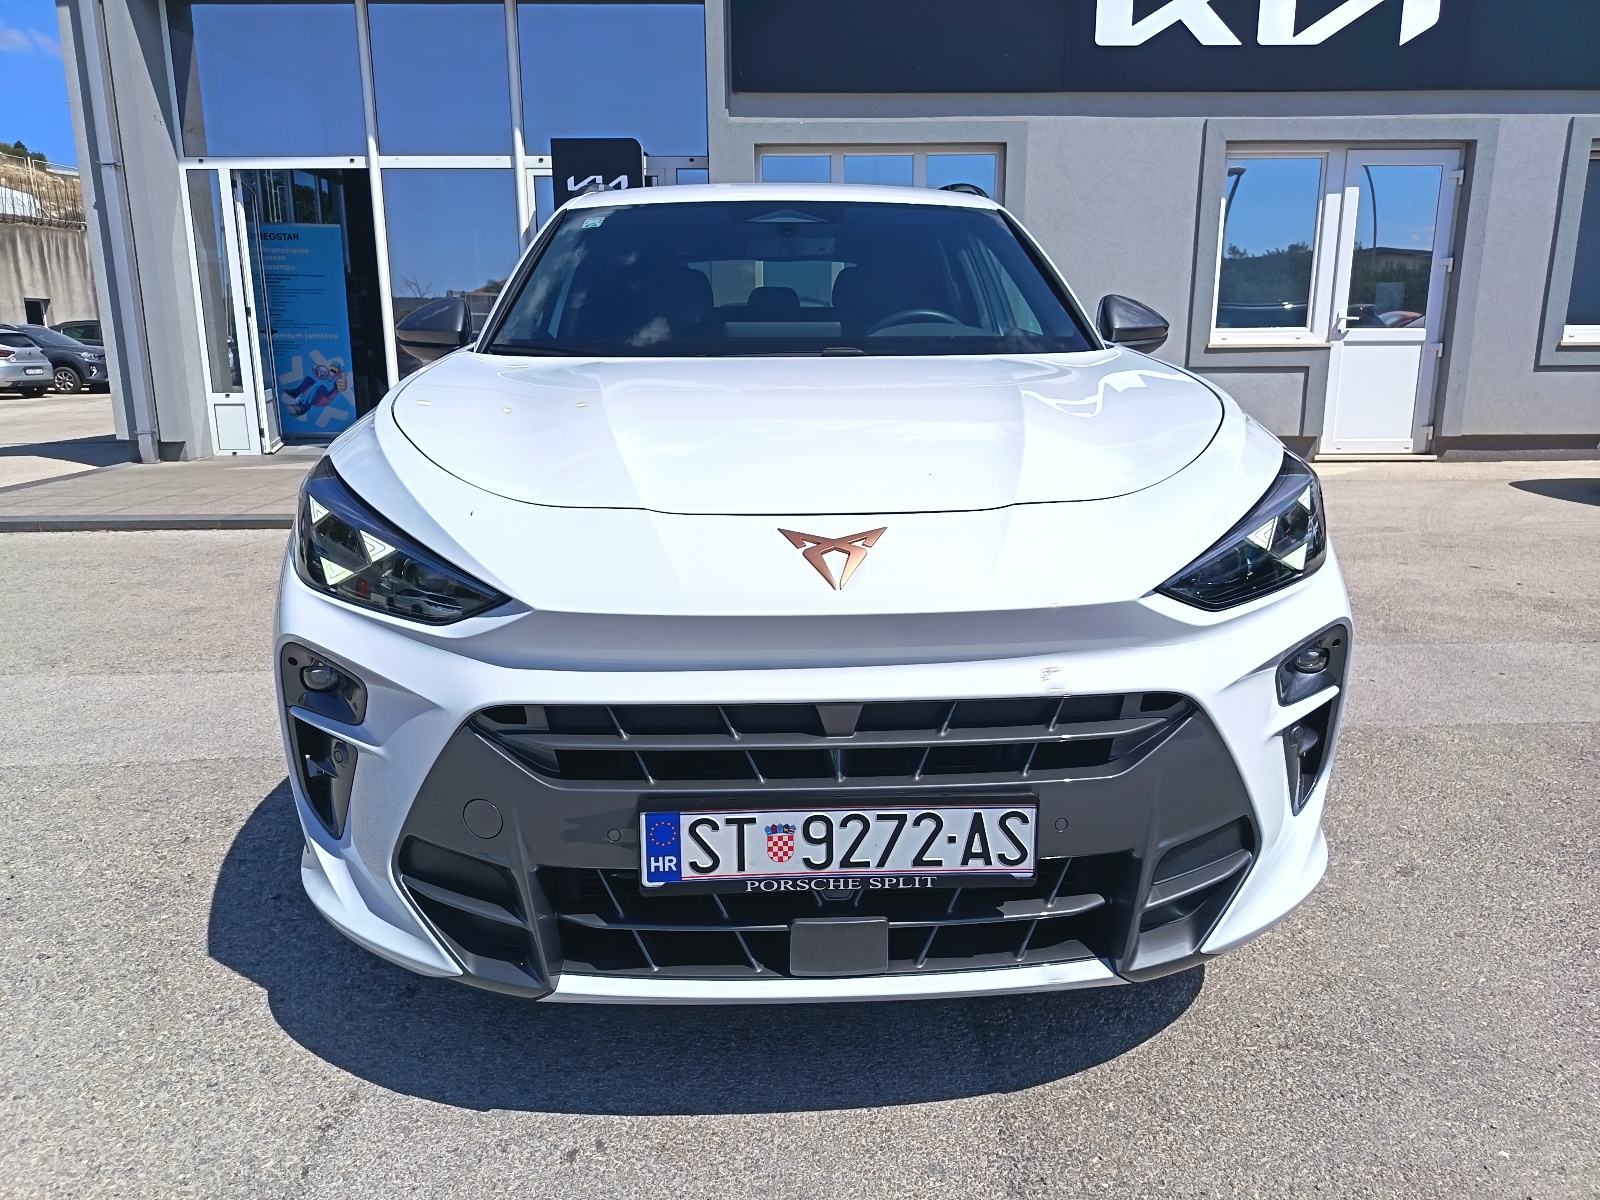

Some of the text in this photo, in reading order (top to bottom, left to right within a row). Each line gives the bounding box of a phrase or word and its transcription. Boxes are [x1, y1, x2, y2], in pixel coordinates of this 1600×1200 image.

[689, 817, 757, 873] ST
[650, 856, 677, 873] HR
[745, 875, 938, 893] PORSCHE SPLIT
